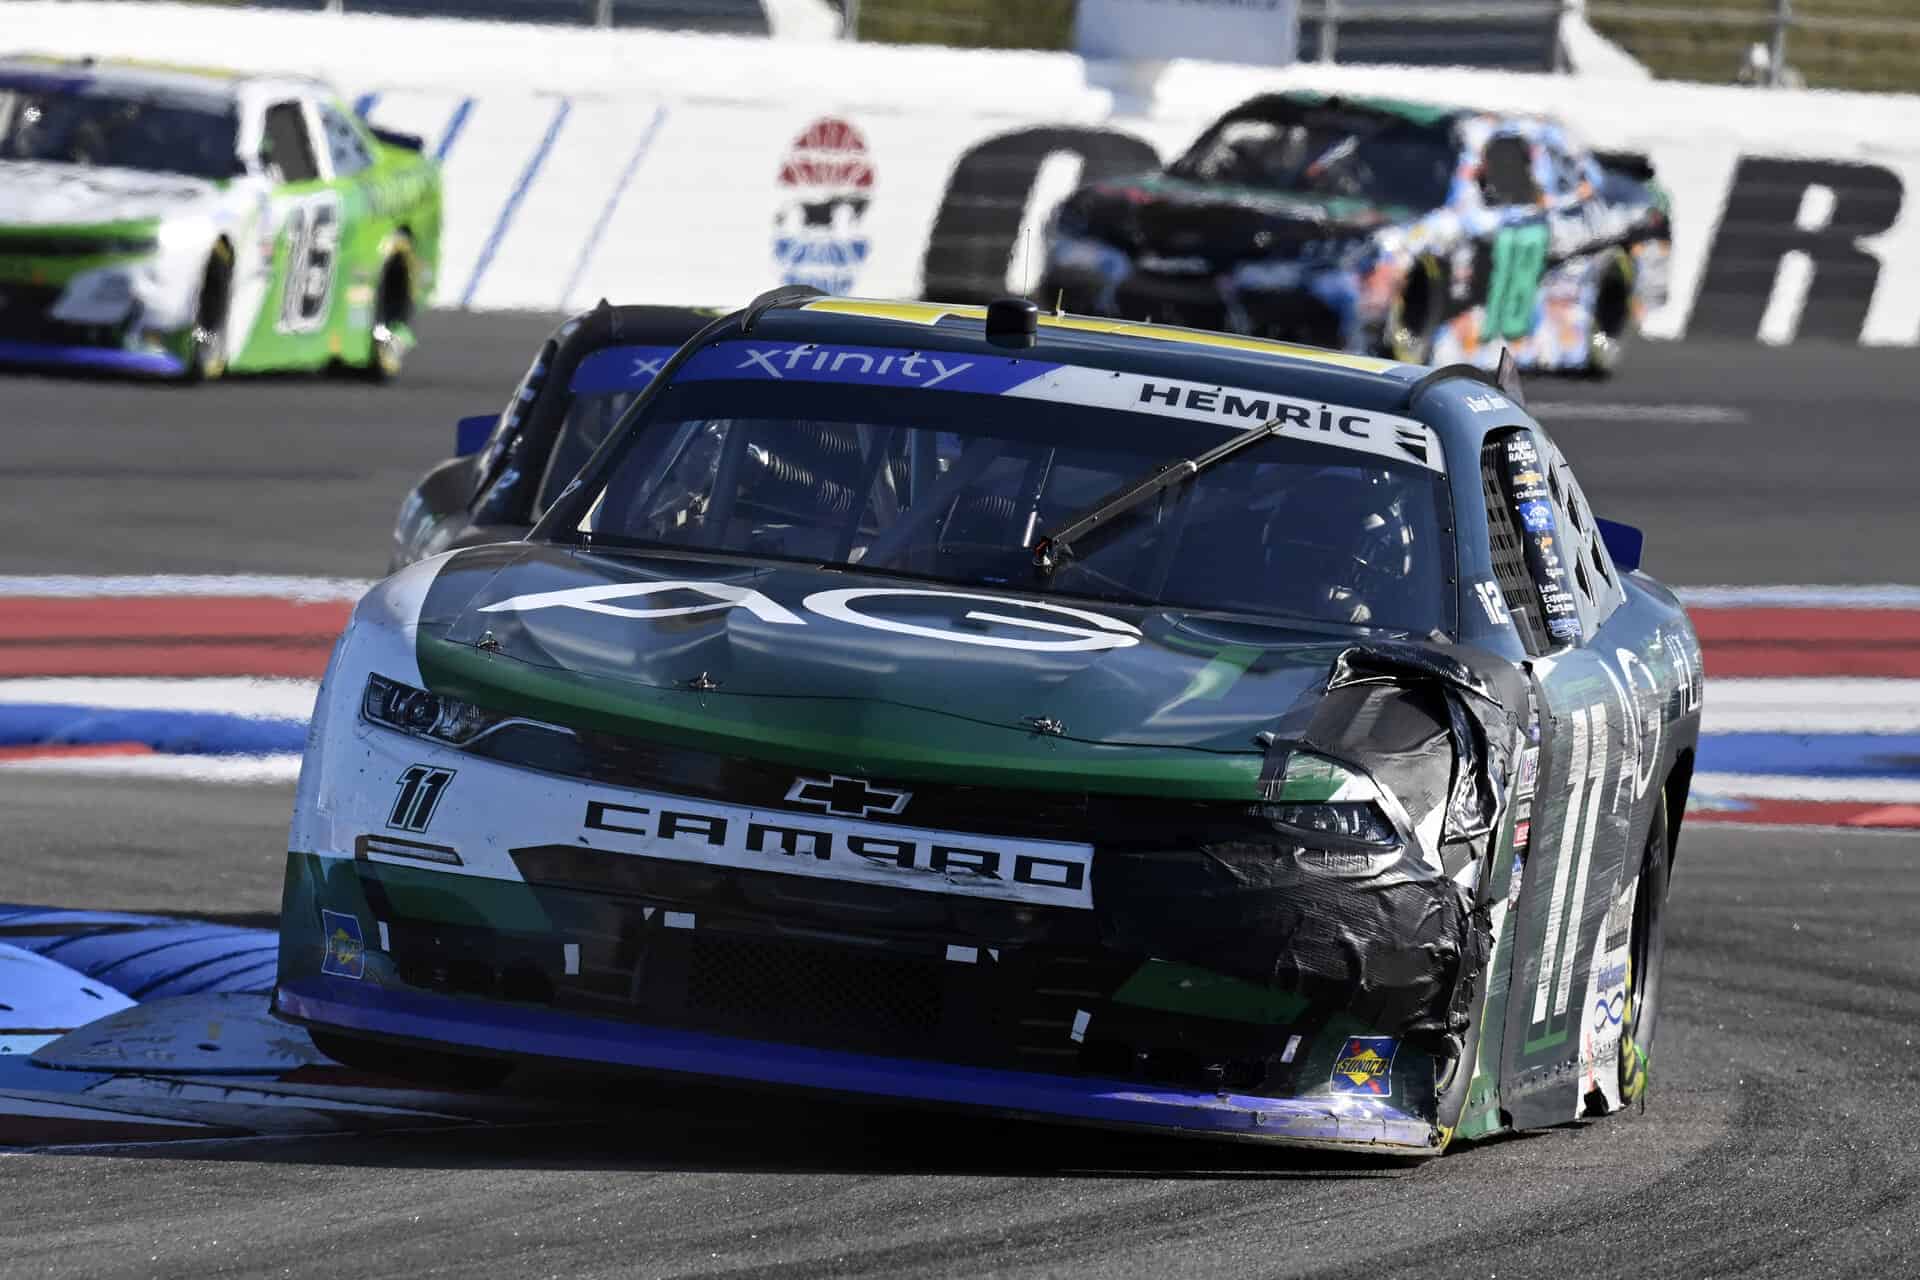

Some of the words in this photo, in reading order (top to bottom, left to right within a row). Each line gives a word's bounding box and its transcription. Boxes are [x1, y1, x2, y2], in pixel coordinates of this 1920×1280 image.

[736, 343, 975, 388] xfinity
[1139, 382, 1371, 439] HEMRIC
[385, 762, 458, 834] 11
[584, 799, 1086, 890] CAMARO
[1336, 1056, 1388, 1076] SUNOCO
